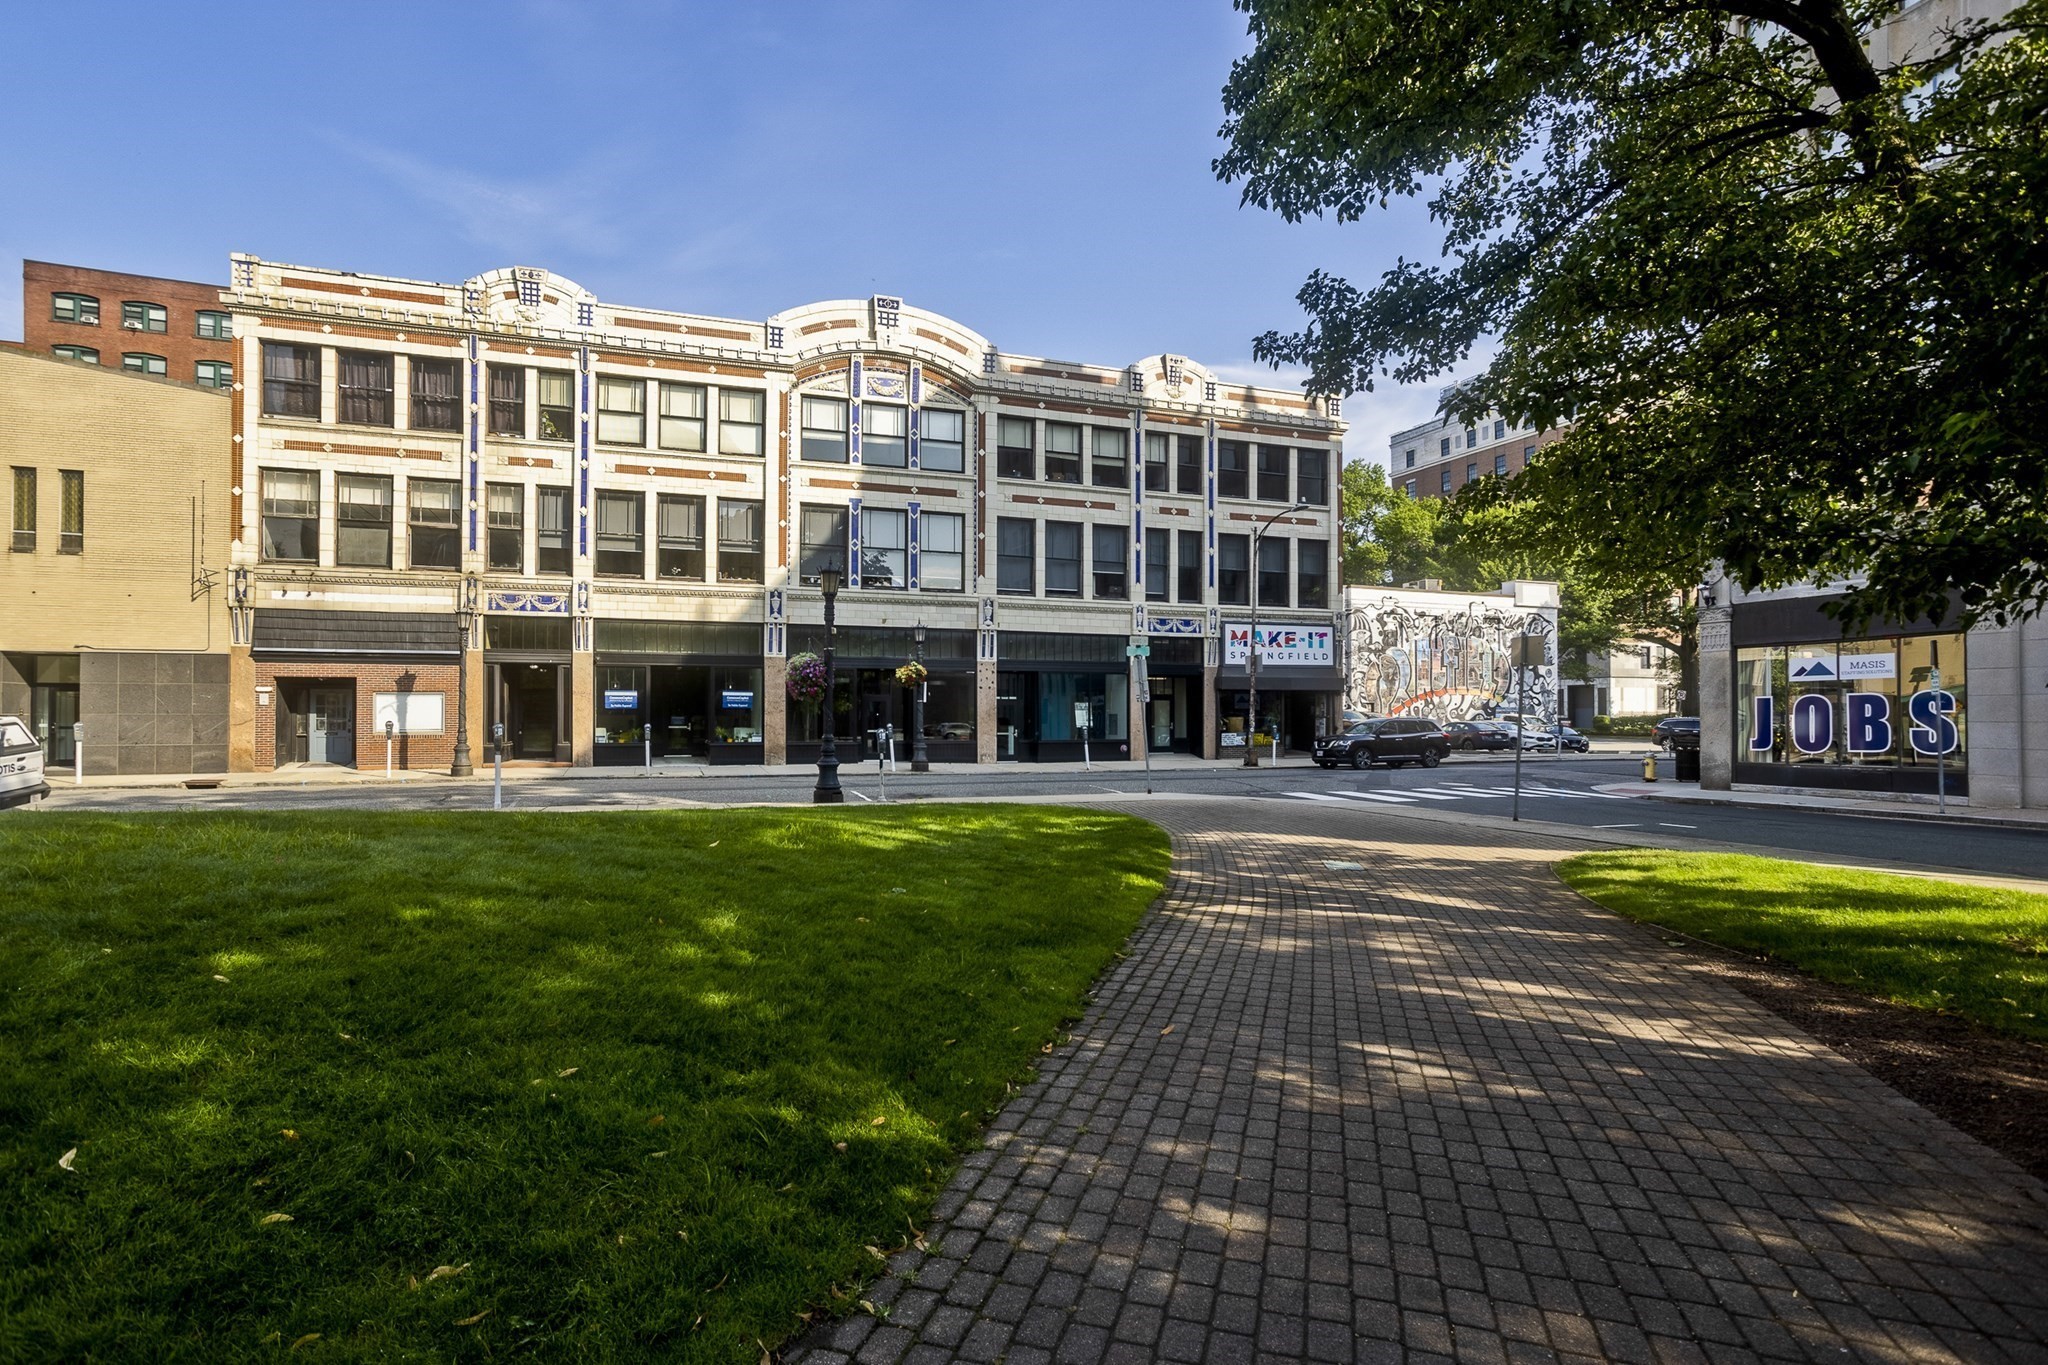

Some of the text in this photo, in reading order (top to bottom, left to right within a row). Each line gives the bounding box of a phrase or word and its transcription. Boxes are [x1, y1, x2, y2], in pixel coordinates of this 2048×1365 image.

[1230, 630, 1328, 648] MAKE-IT
[1230, 651, 1329, 660] SPNGFIELD
[1850, 660, 1886, 669] MASIS
[1750, 690, 1958, 756] JOBS
